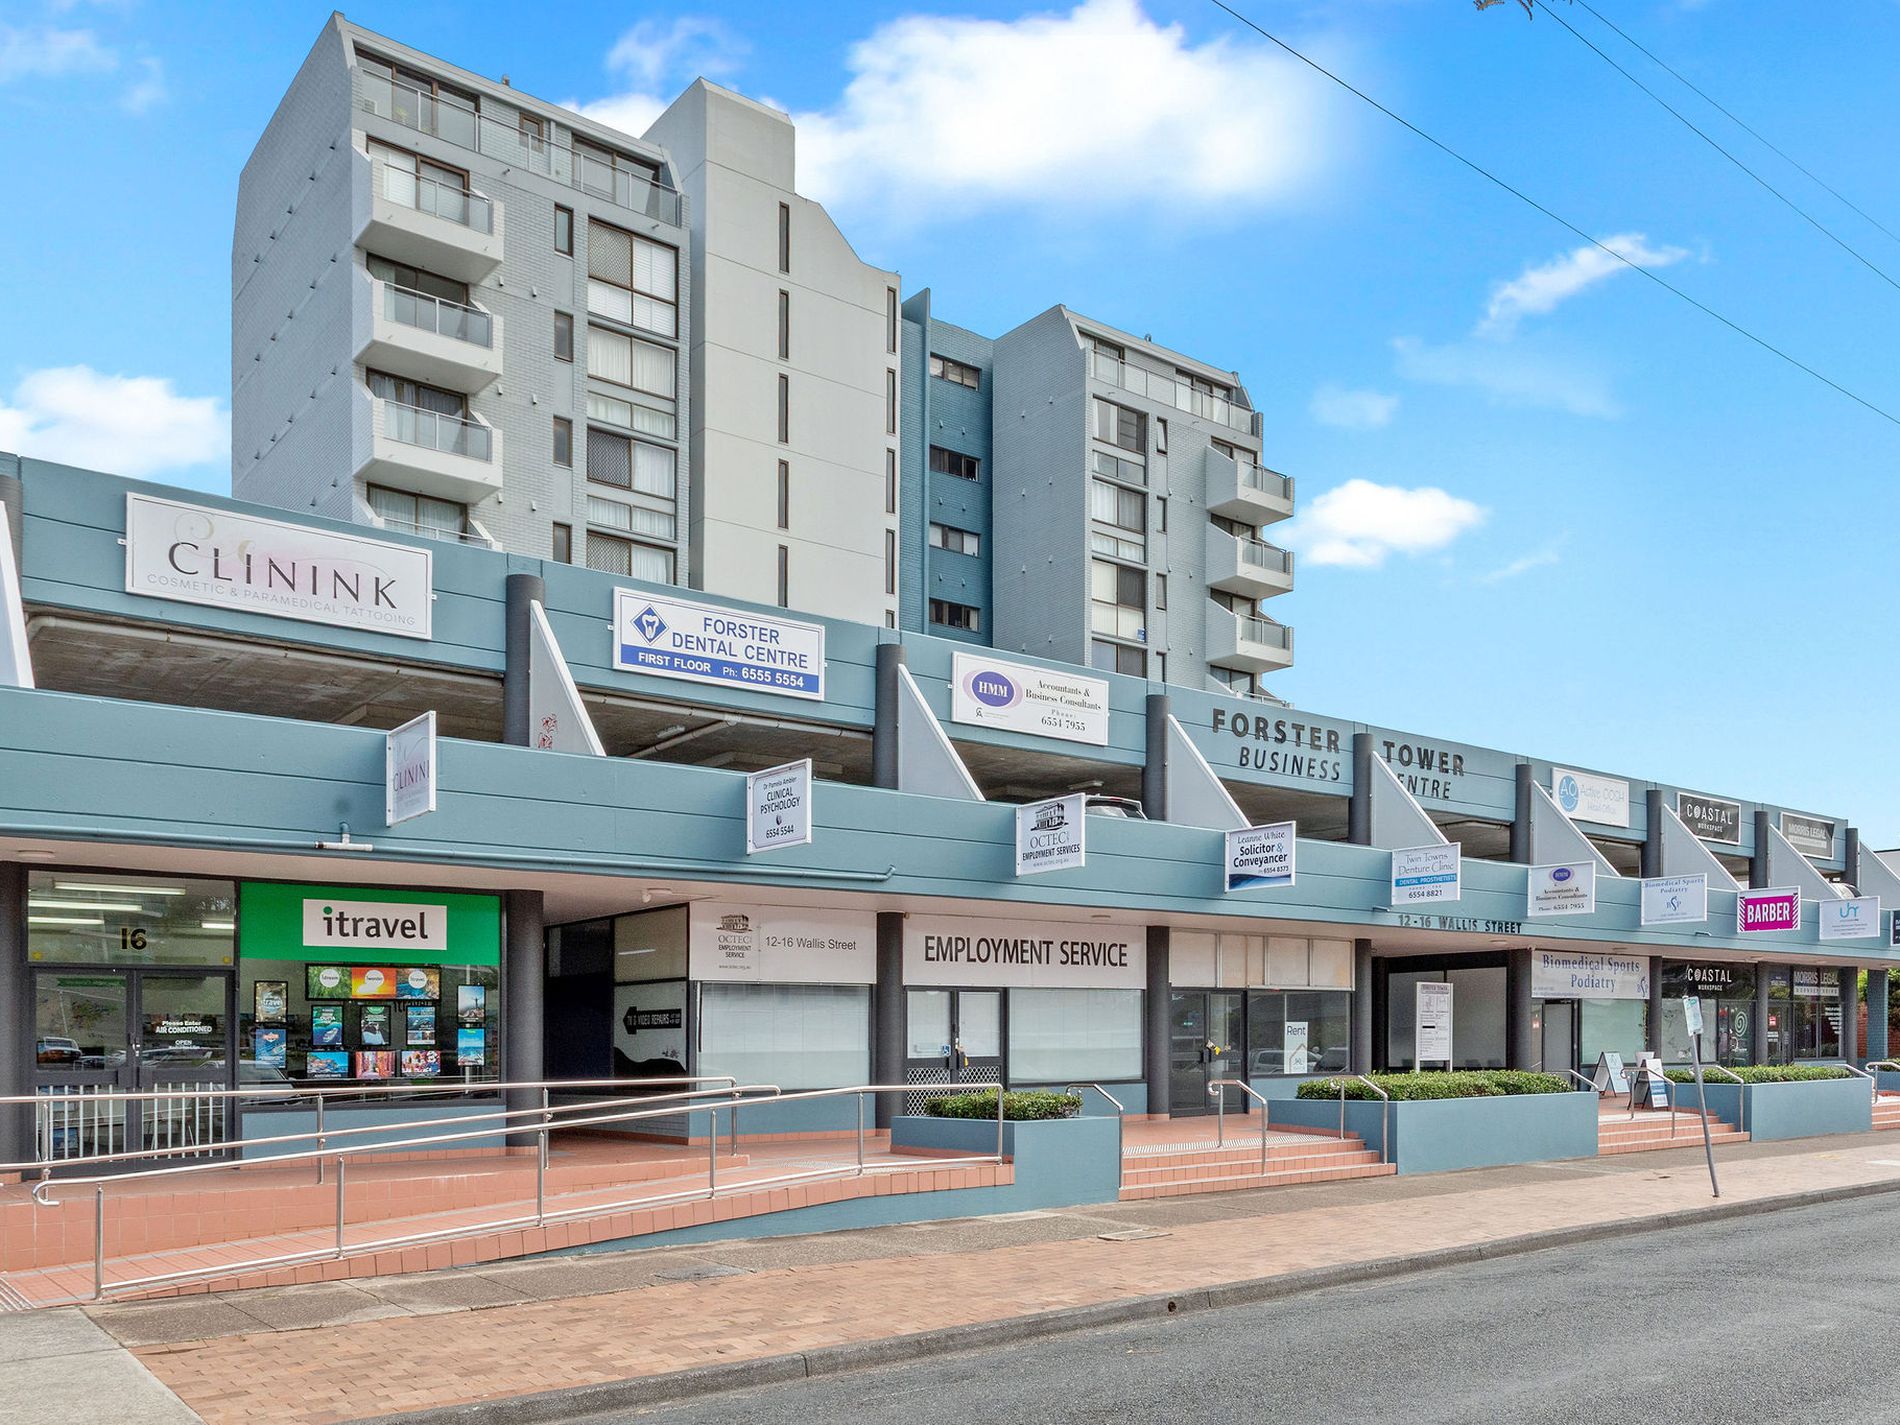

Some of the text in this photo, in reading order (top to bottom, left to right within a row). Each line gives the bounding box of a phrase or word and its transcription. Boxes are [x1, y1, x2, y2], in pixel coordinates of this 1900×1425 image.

[168, 541, 397, 609] CLININK
[147, 573, 415, 626] COSMETIC & PARAMEDICAL TATTOOING
[703, 617, 780, 644] FORSTER
[672, 632, 808, 669] DENTAL CENTRE
[638, 652, 804, 688] FIRST FLOOR Ph: 6555 5554
[978, 681, 1008, 698] HMM
[1037, 680, 1091, 697] Accountants &
[1026, 689, 1101, 710] Business Consultants
[1065, 719, 1086, 731] 7955
[1212, 708, 1464, 777] FORSTER TOWER
[1239, 746, 1452, 799] BUSINESS ENTRE
[767, 787, 793, 801] CLINICAL
[760, 797, 800, 814] PSYCHOLOGY
[1686, 804, 1733, 825] COASTAL
[780, 825, 794, 836] 5544
[1697, 822, 1723, 833] WORKSPACE
[1030, 832, 1066, 849] OCTEC
[1023, 844, 1081, 861] EMPLOYMENT SERVICES
[1240, 843, 1275, 856] Solicitor
[1405, 852, 1448, 864] Twin Towns
[1233, 854, 1288, 868] Conveyancer
[1398, 861, 1454, 876] Denture Clinic
[1747, 901, 1790, 924] BARBER
[322, 906, 429, 939] itravel
[1439, 915, 1478, 931] WALLIS
[1484, 920, 1522, 934] STREET
[121, 928, 147, 950] 16
[718, 935, 750, 944] OCTEC
[765, 936, 857, 951] 12-16 Wallis Street
[924, 936, 1128, 967] EMPLOYMENT SERVICE
[1543, 954, 1640, 975] Biomedical Sports
[1571, 974, 1616, 993] Podiatry
[1687, 968, 1732, 983] COASTAL
[1820, 972, 1839, 985] LEGAL
[651, 1013, 670, 1025] REPAIRS
[155, 1025, 213, 1034] AIR CONDITIONED
[1287, 1025, 1306, 1036] Rent
